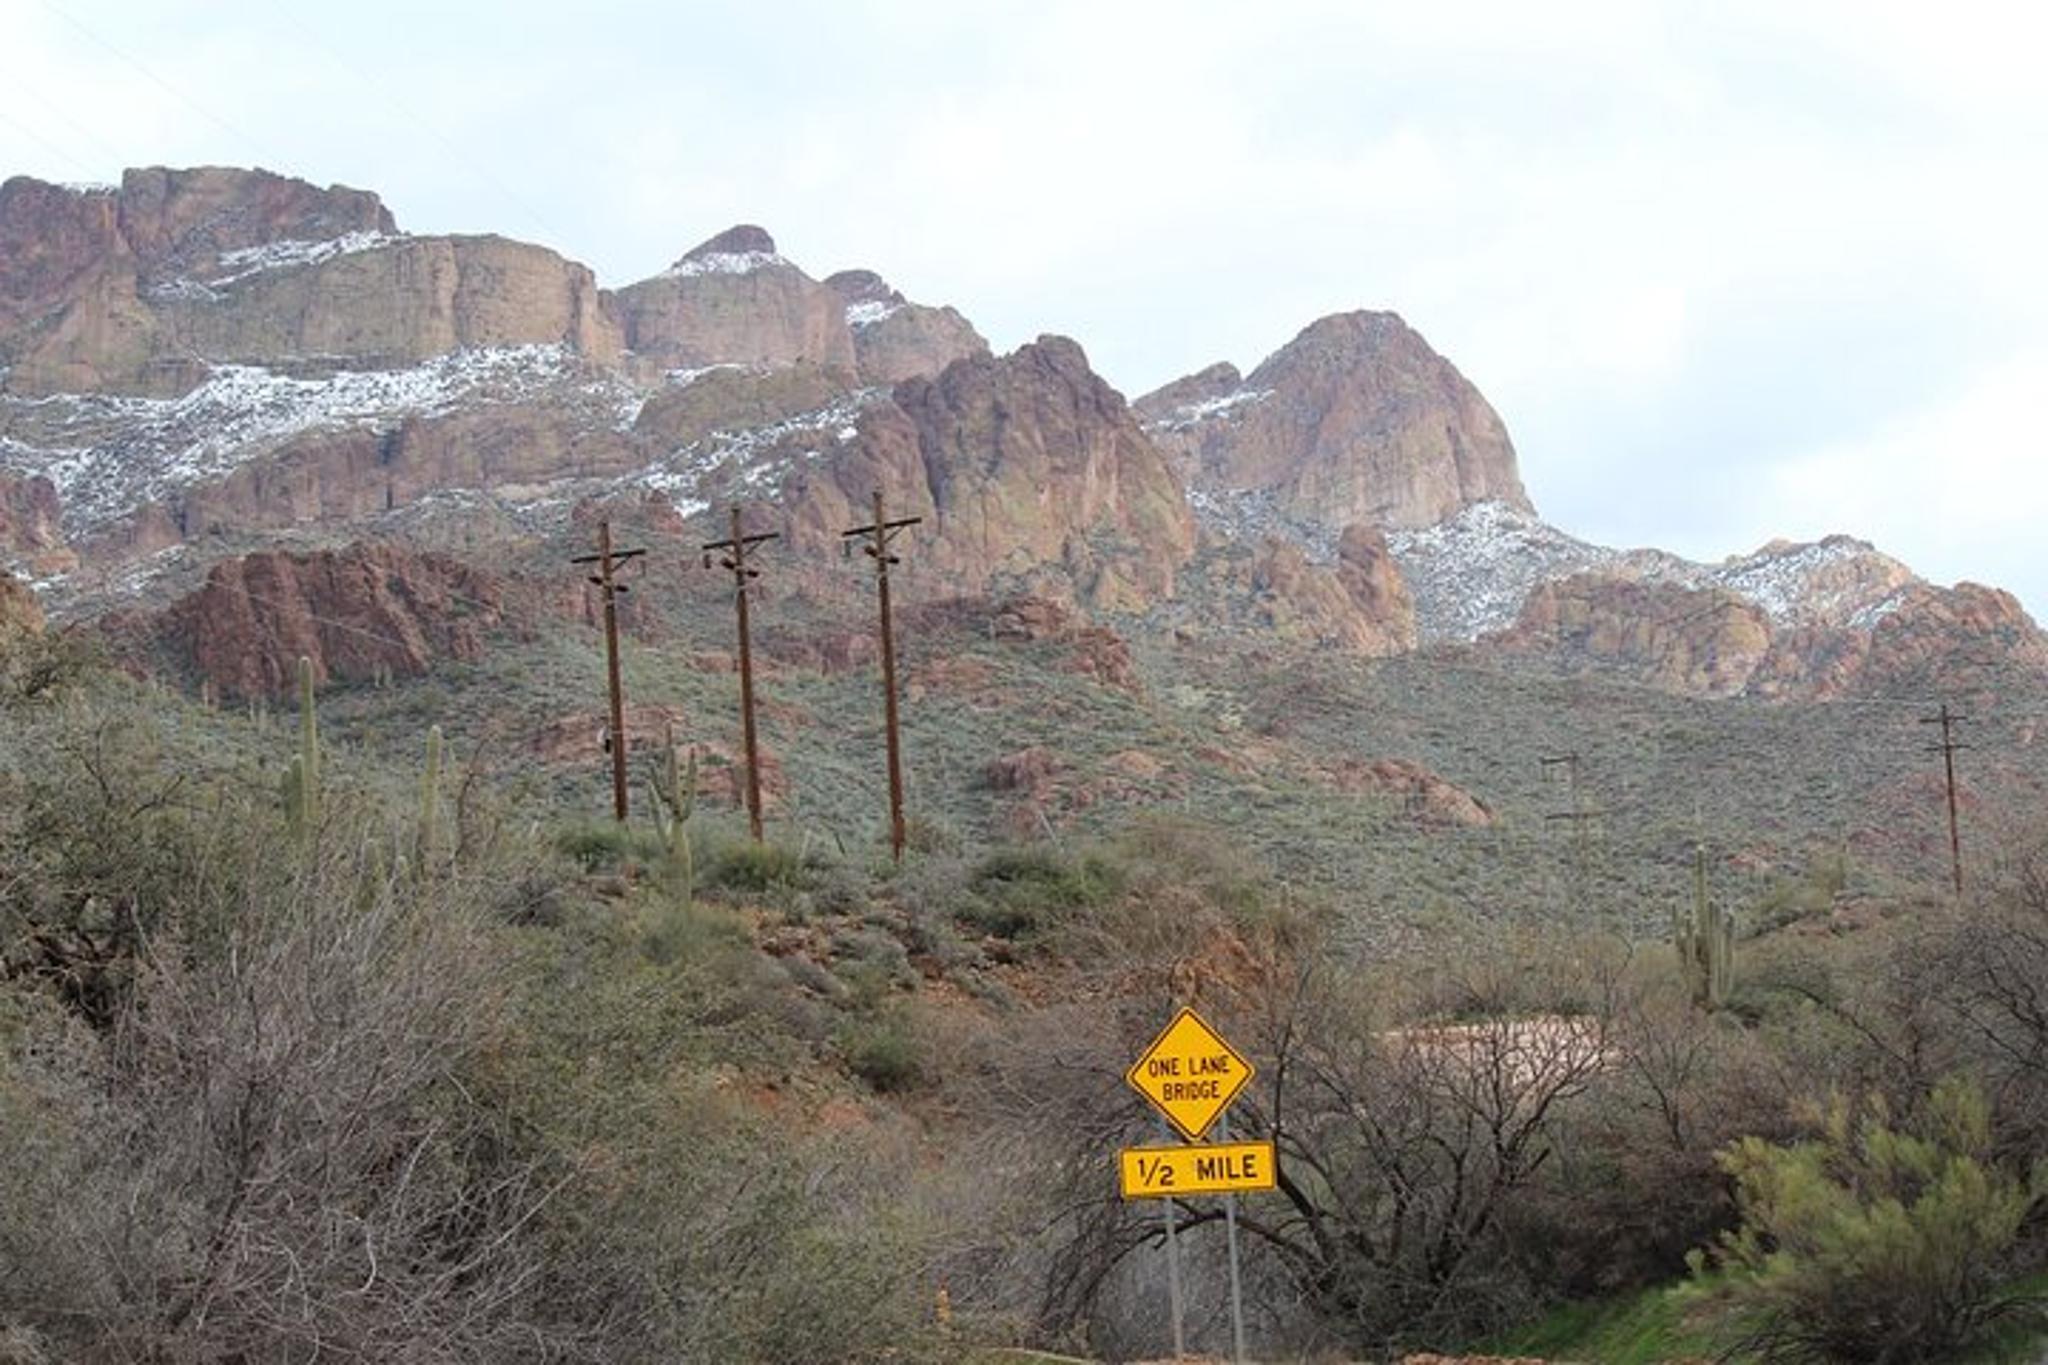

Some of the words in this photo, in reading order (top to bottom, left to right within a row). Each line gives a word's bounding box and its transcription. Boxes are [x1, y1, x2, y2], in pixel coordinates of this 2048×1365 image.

[1148, 1057, 1180, 1078] ONE
[1188, 1055, 1230, 1075] LANE
[1163, 1081, 1220, 1101] BRIDGE
[1137, 1156, 1175, 1186] 1/2
[1196, 1154, 1257, 1180] MILE
